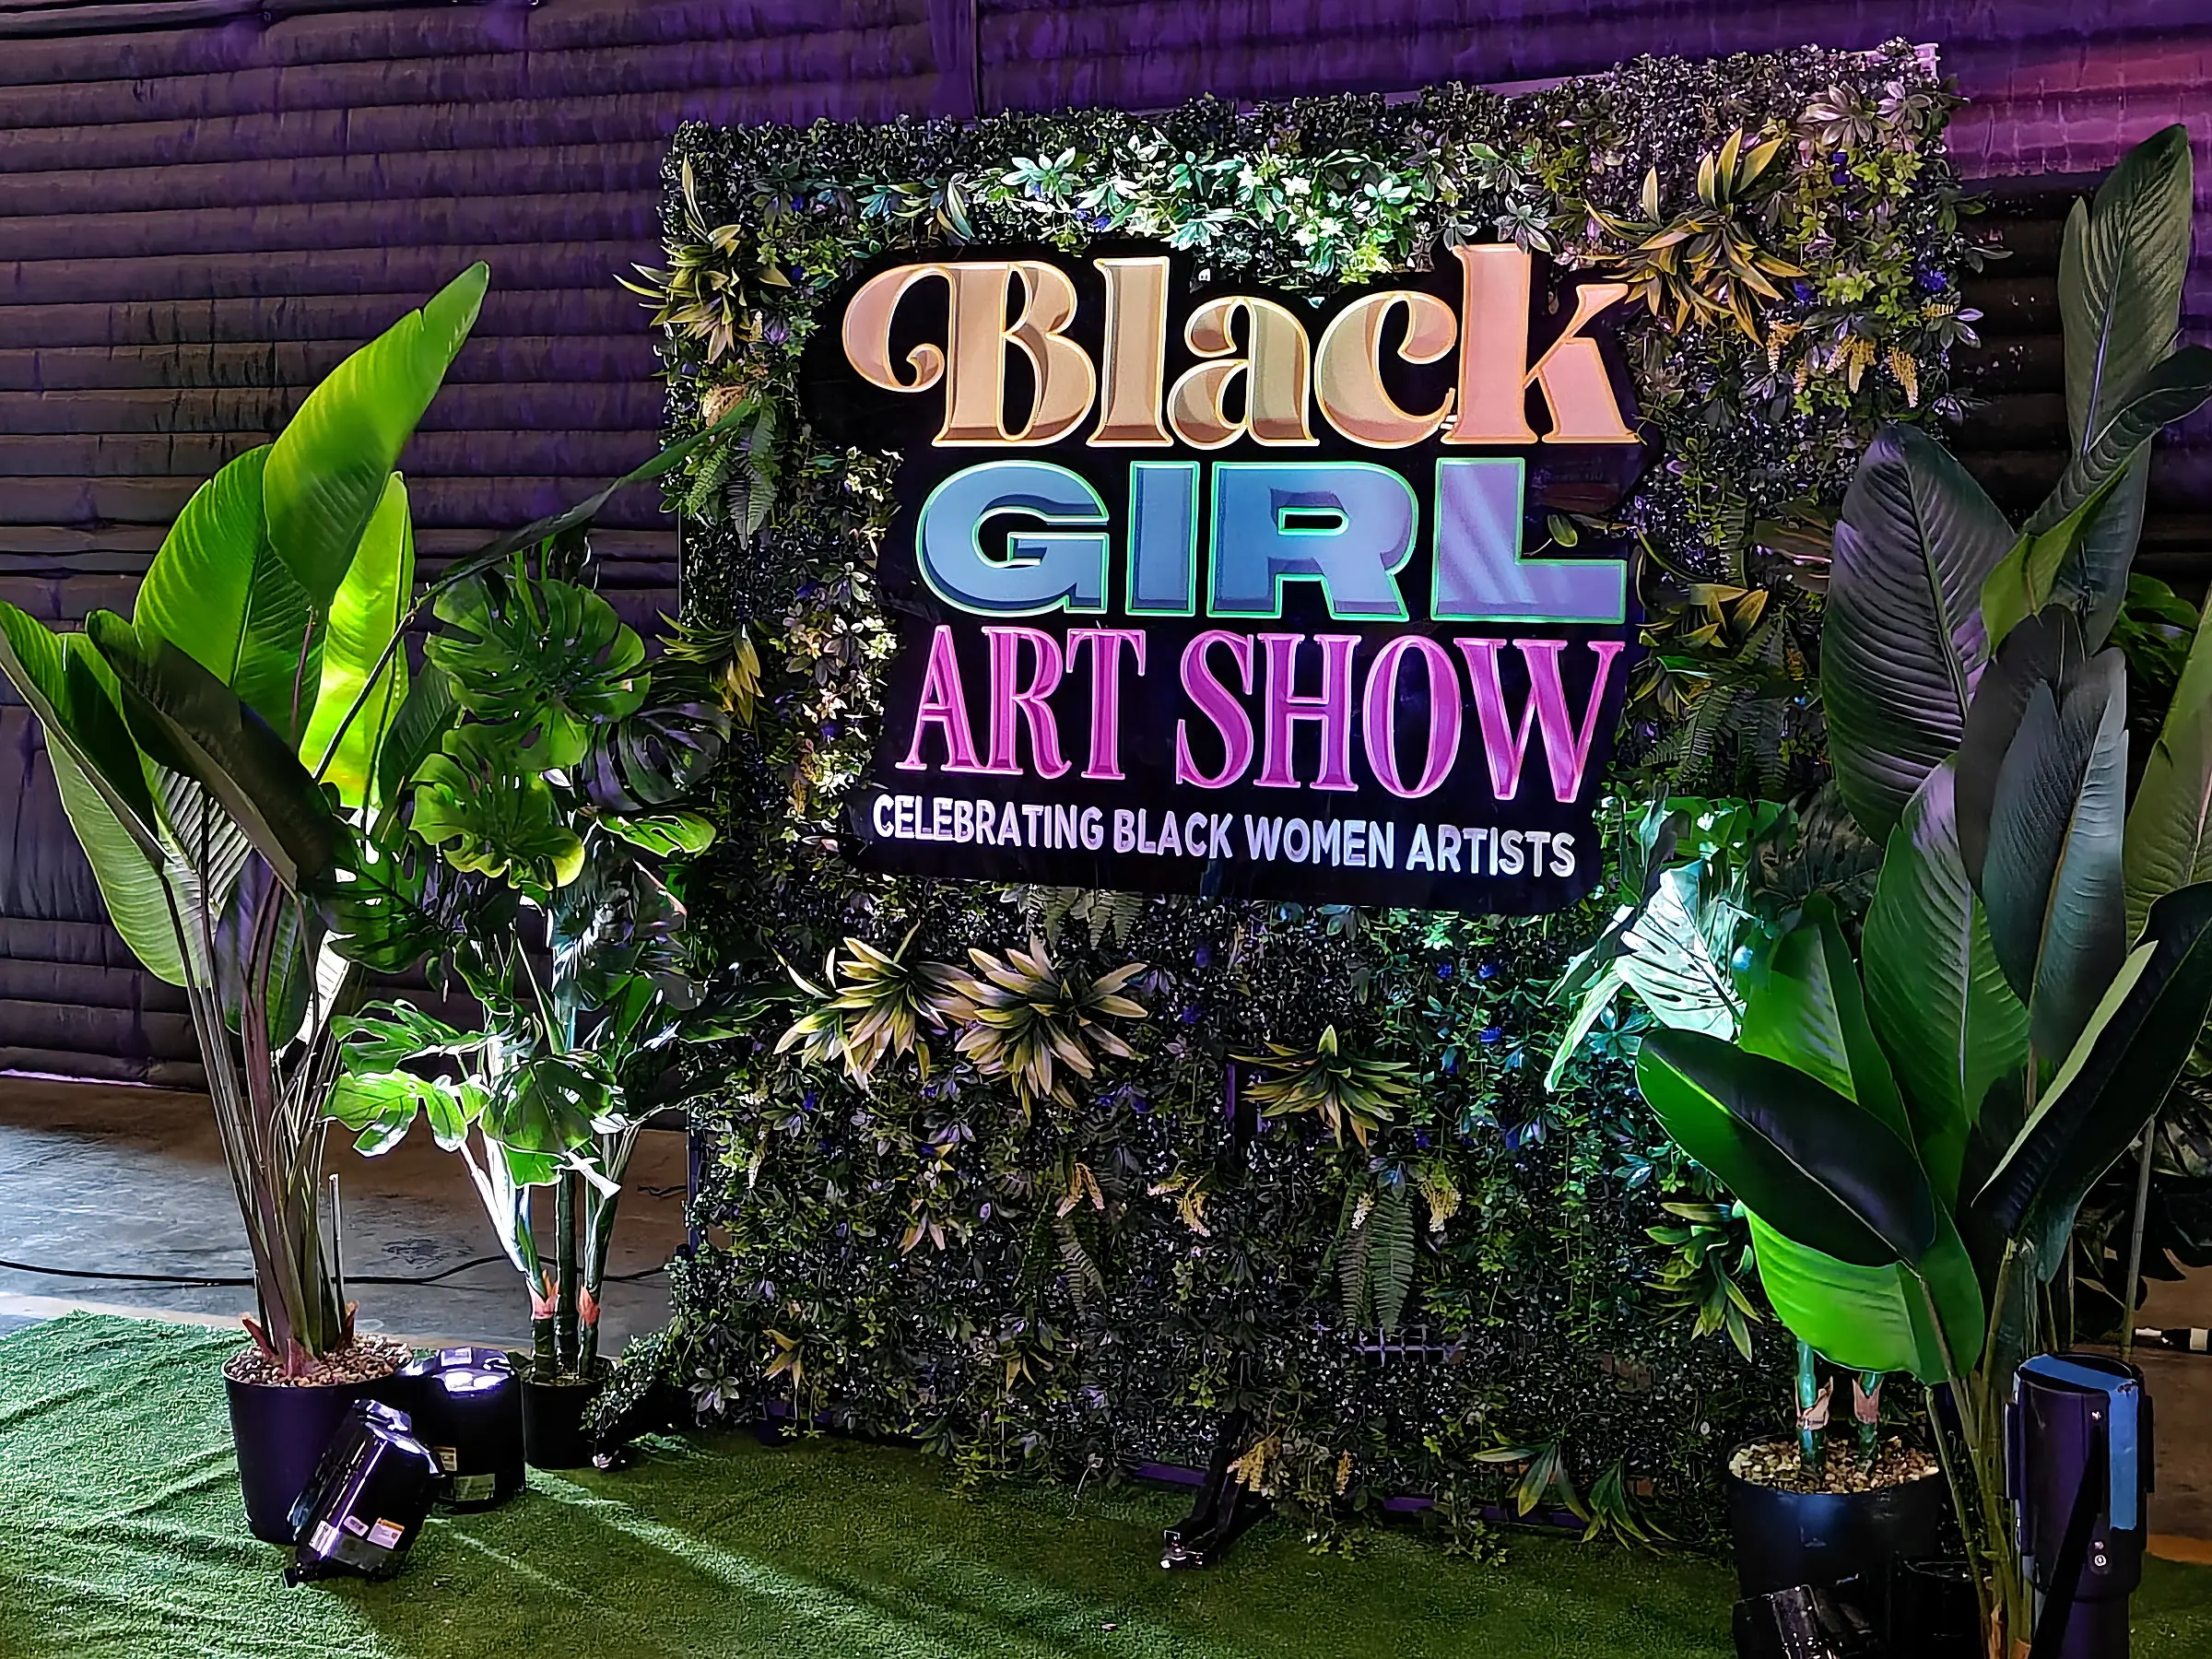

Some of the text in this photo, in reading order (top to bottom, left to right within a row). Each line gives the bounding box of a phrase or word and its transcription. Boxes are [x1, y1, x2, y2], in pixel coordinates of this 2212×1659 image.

[841, 243, 1639, 449] Black
[915, 457, 1627, 624] GIRL
[894, 625, 1626, 803] ART SHOW
[872, 794, 1577, 877] CELEBRATING BLACK WOMEN ARTISTS
